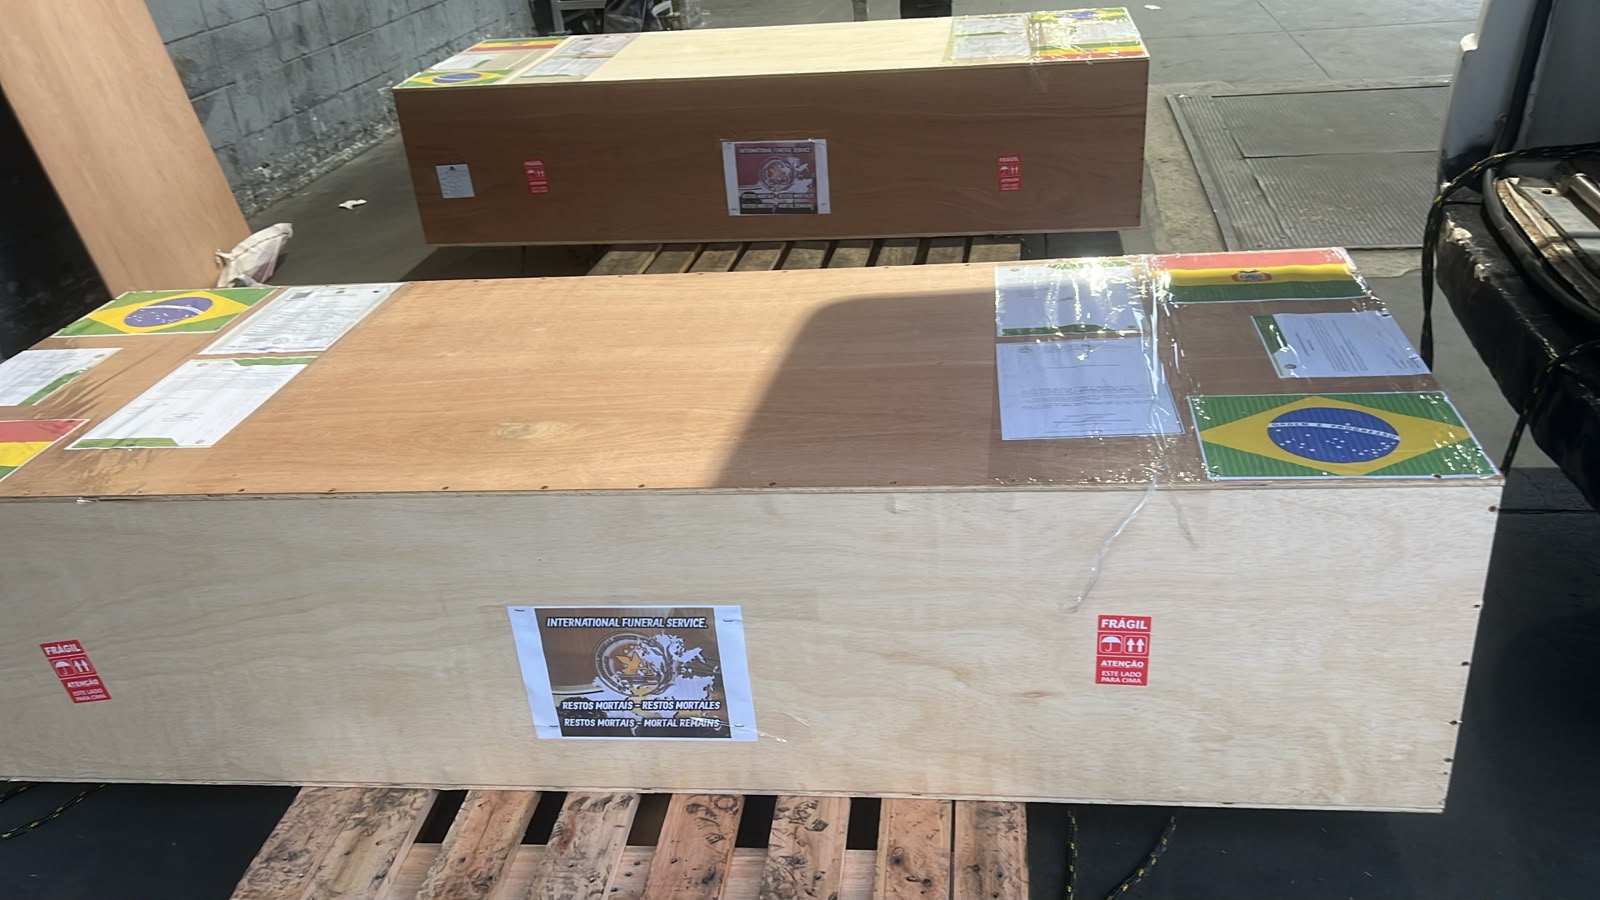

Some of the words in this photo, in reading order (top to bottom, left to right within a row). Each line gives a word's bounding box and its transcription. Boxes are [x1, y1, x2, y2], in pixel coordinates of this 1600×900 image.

[547, 618, 620, 628] INTERNATIONAL
[622, 618, 665, 628] FUNERAL
[666, 618, 708, 628] SERVICE.
[1101, 617, 1148, 630] FRÁGIL
[44, 643, 82, 656] FRÁGIL
[1100, 660, 1144, 668] ATENÇÃO
[562, 702, 594, 710] RESTOS
[595, 702, 634, 710] MORTAIS
[642, 702, 674, 710] RESTOS
[675, 702, 720, 710] MORTALES
[564, 719, 596, 727] RESTOS
[597, 719, 635, 728] MORTAIS
[644, 719, 677, 728] MORTAL
[679, 718, 721, 728] REMAINS
